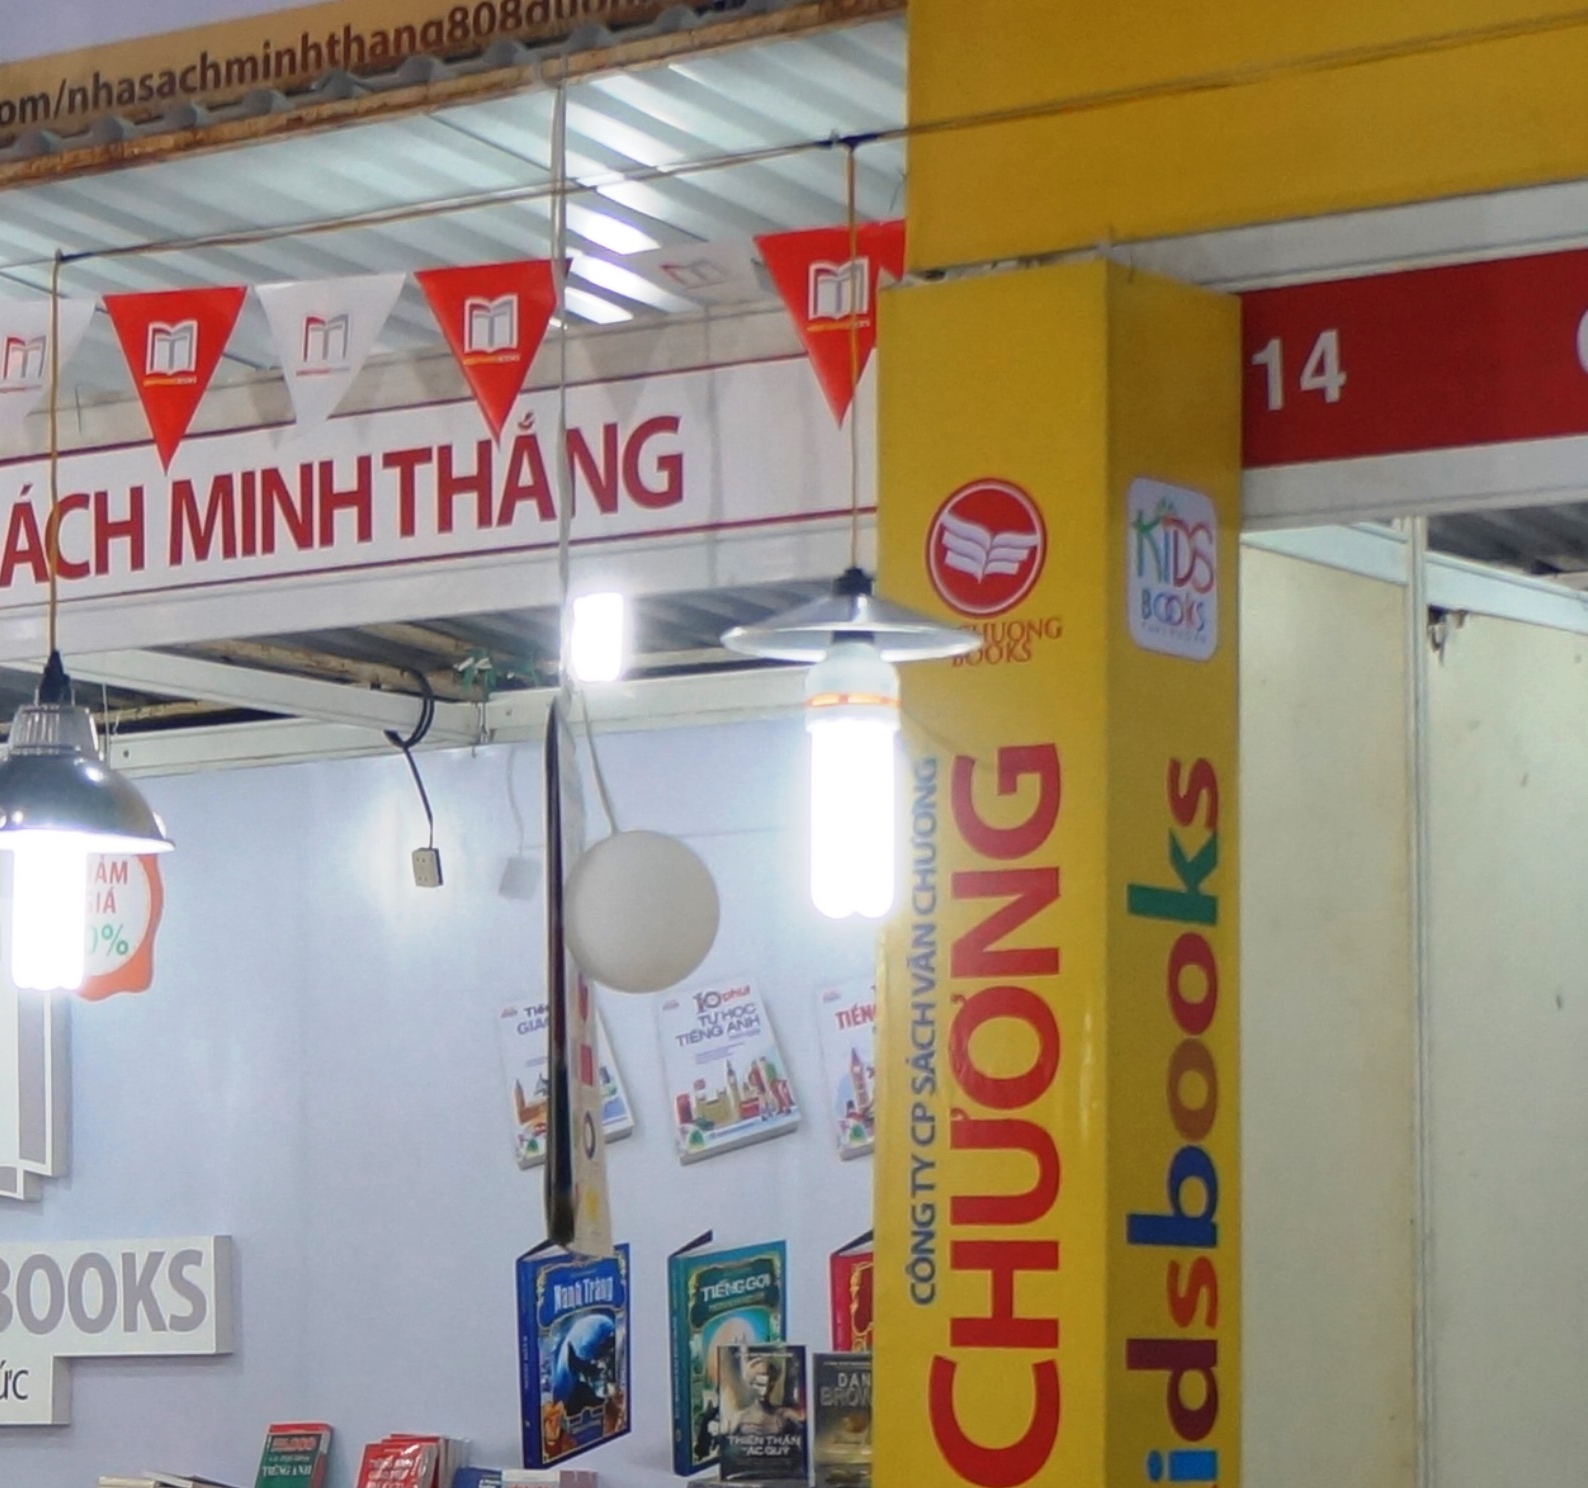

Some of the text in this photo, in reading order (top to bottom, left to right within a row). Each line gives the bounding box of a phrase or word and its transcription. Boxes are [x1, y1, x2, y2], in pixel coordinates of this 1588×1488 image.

[1251, 329, 1347, 412] 14
[1131, 508, 1215, 594] KIDS
[1141, 587, 1205, 632] BOOKS
[905, 924, 938, 995] VĂN
[726, 1015, 761, 1036] ANH
[835, 1003, 876, 1031] TIẾN
[905, 1003, 938, 1096] SÁCH
[910, 1102, 938, 1146] CP
[911, 1155, 938, 1199] TY
[905, 1203, 938, 1306] CÔNG
